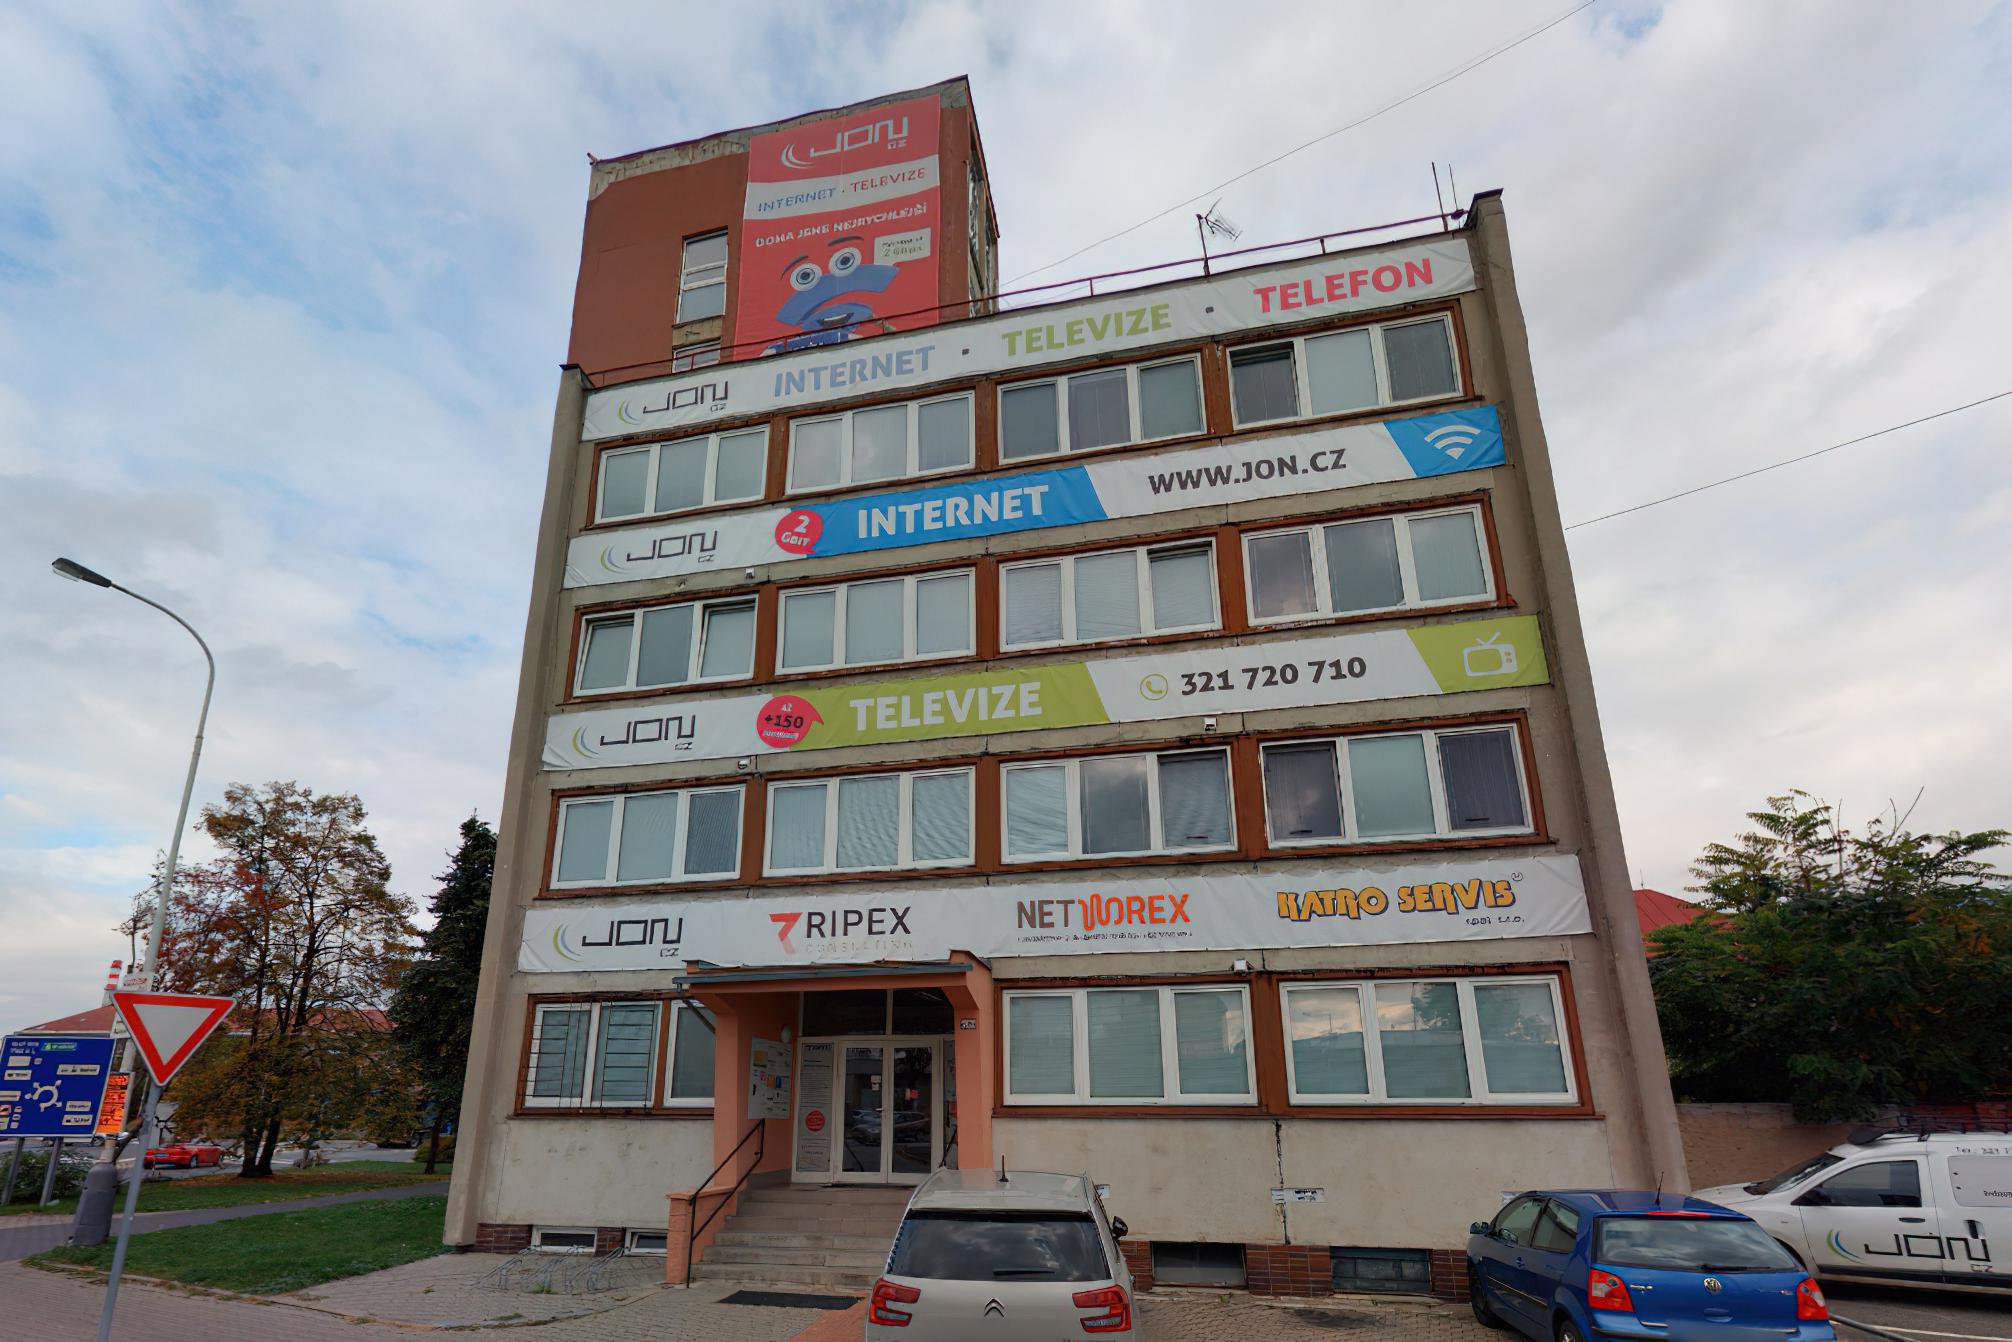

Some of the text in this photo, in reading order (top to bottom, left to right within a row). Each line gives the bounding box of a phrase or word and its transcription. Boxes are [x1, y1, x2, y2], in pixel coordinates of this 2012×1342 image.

[757, 167, 926, 213] INTERNET TELEVIZE
[774, 258, 1434, 398] INTERNET TELEVIZE TELEFON
[1148, 448, 1347, 495] WWW.JON.CZ
[793, 514, 810, 533] 2
[857, 484, 1050, 539] INTERNET
[1181, 655, 1366, 696] 321 720 710
[850, 681, 1043, 731] TELEVIZE
[1398, 878, 1516, 915] SERVIS
